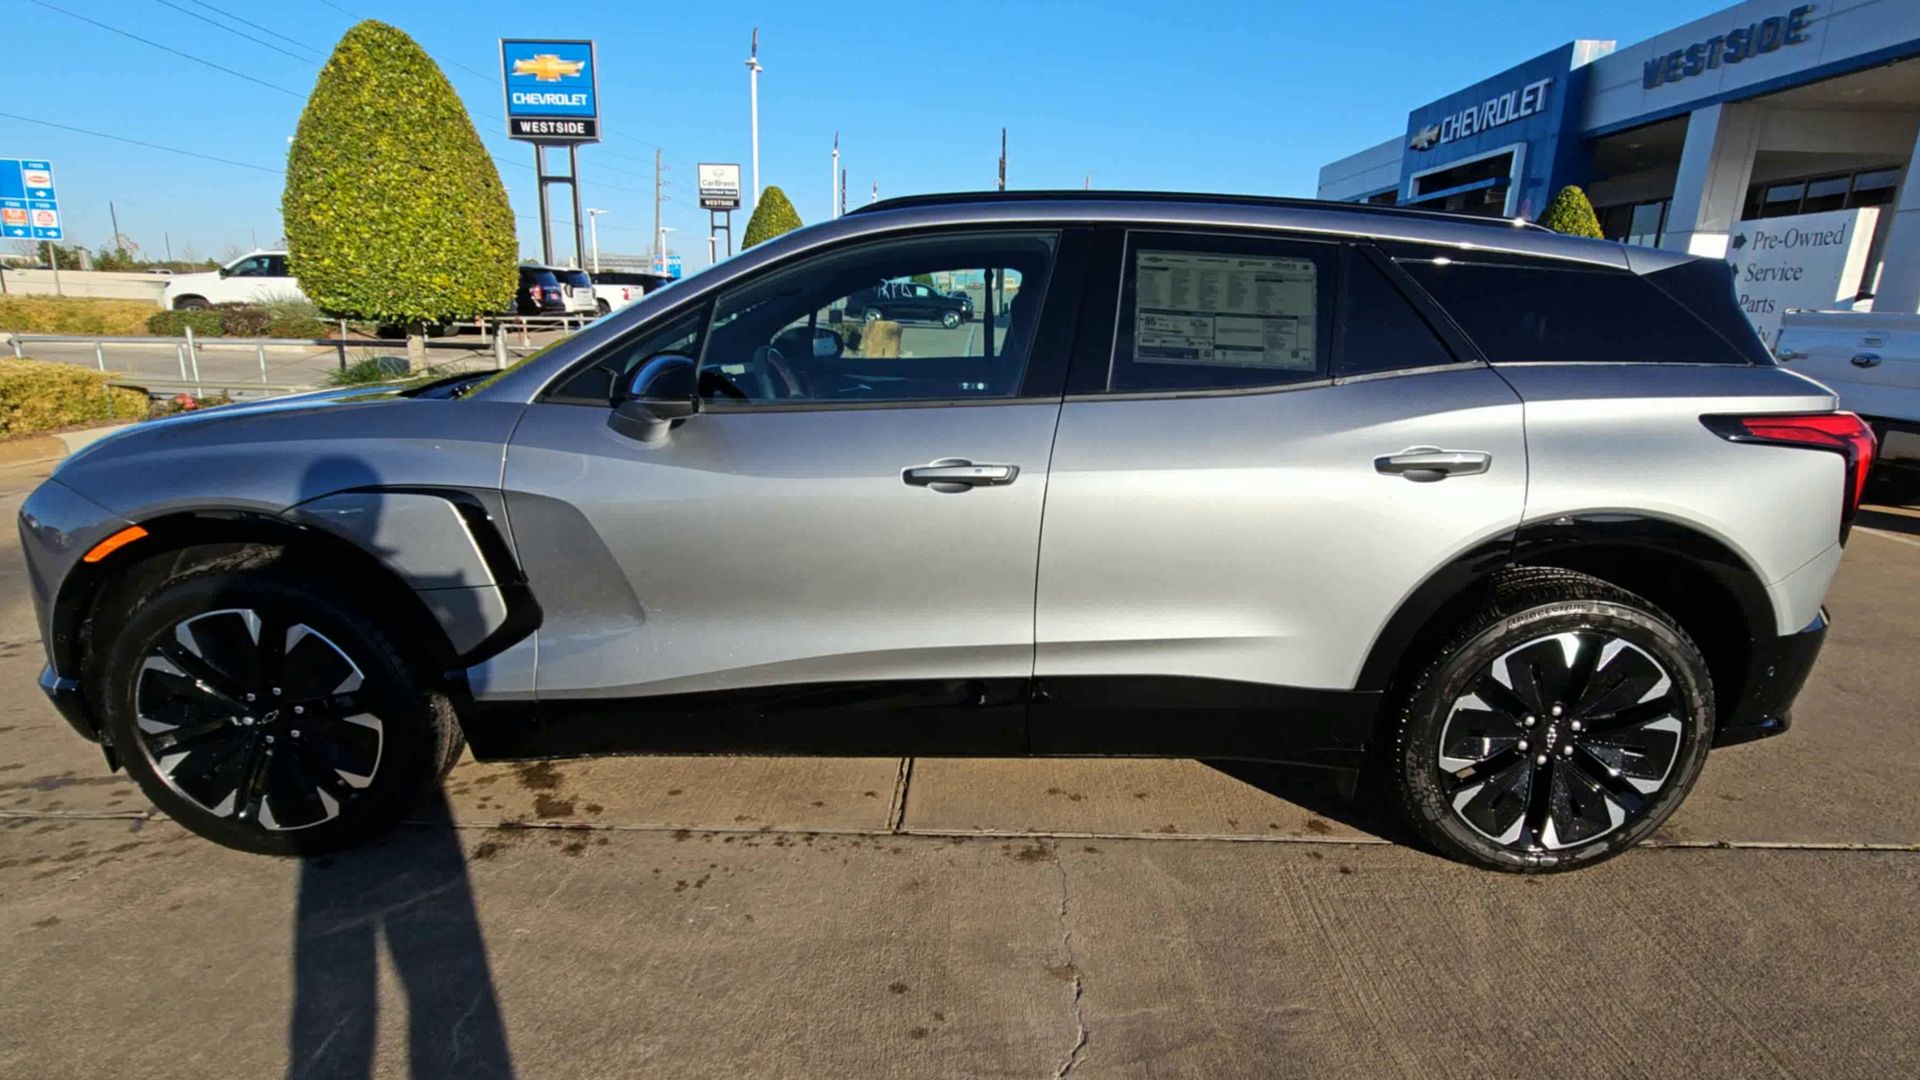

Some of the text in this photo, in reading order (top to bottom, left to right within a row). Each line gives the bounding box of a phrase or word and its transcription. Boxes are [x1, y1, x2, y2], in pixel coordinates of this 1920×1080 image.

[1643, 4, 1815, 90] WESTSIDE
[512, 92, 588, 106] CHEVROLET
[1440, 77, 1553, 144] CHEVROLET
[520, 121, 585, 134] WESTSIDE
[1752, 223, 1847, 251] Pre-Owned
[1744, 261, 1803, 283] Service
[1740, 293, 1776, 314] Parts
